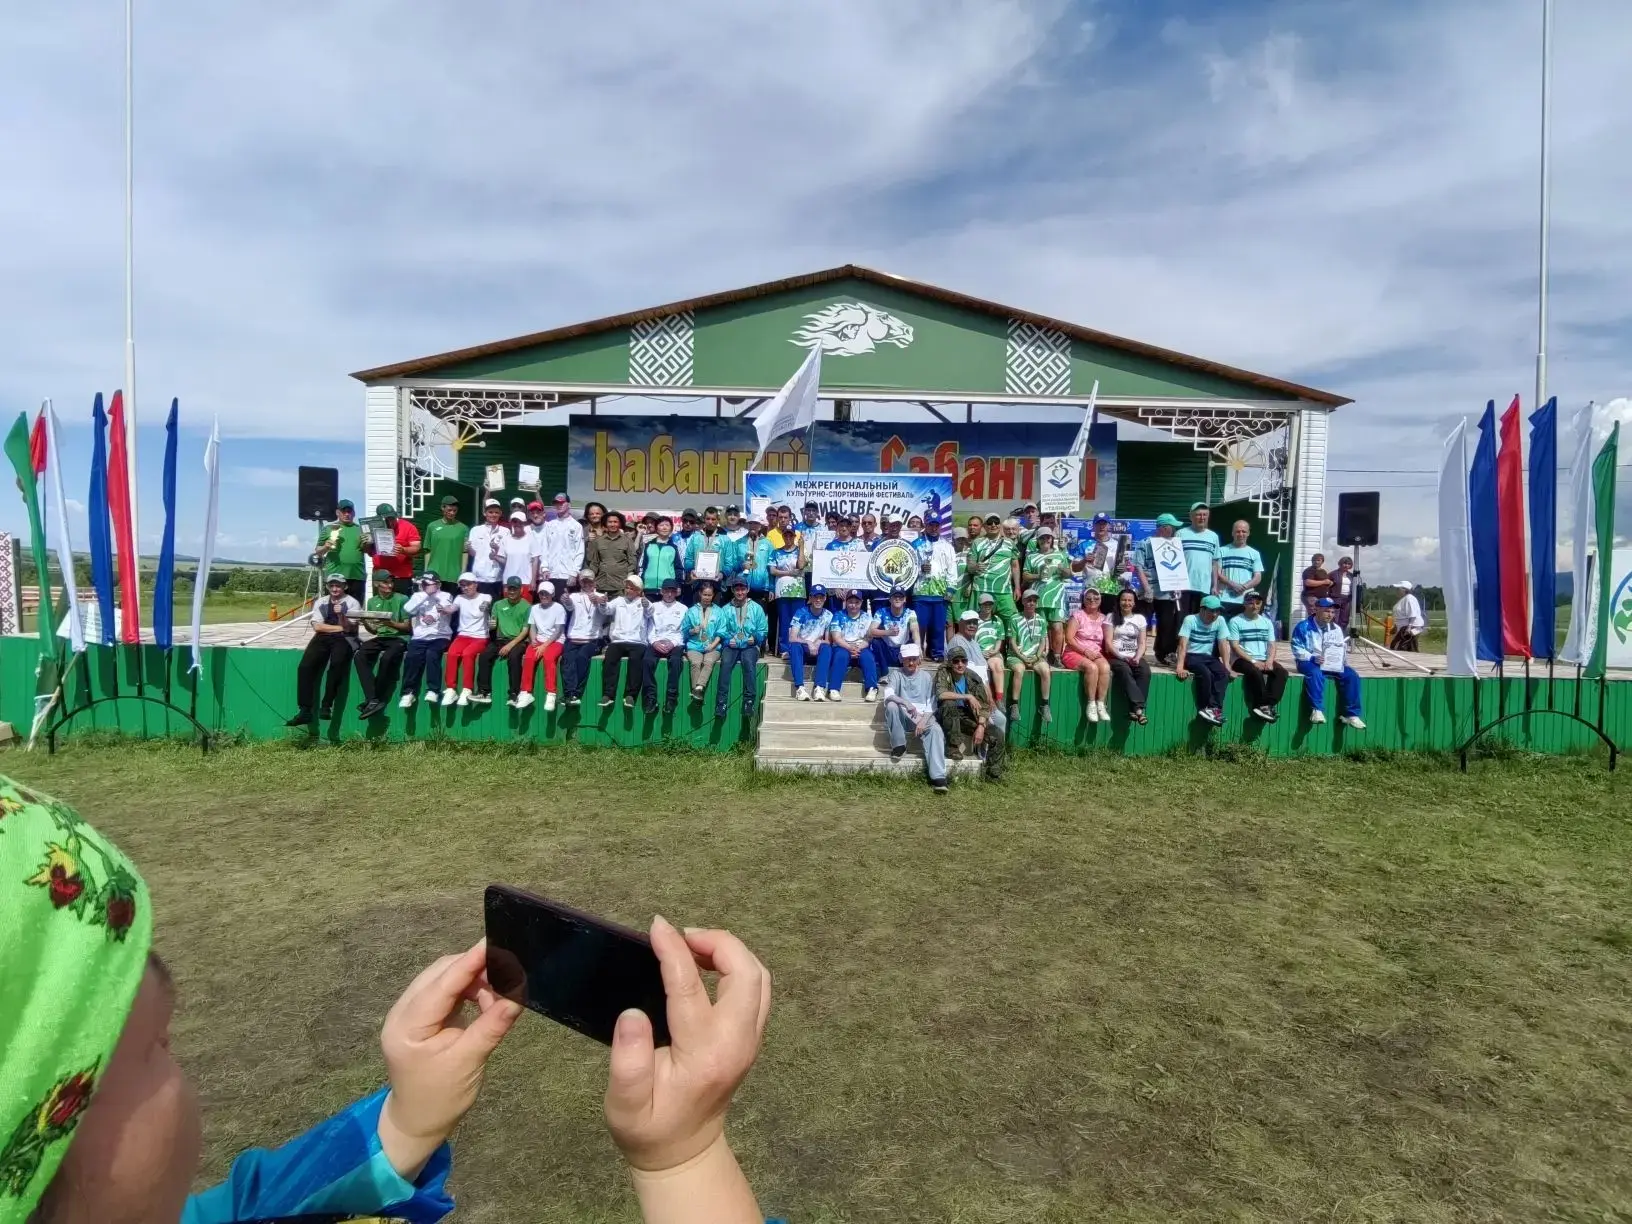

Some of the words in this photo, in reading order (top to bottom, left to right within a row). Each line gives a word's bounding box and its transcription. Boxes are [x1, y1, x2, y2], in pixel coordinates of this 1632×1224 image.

[794, 480, 898, 490] МЕЖРЕГИОНАЛЬНЫЙ
[786, 490, 874, 498] КУЛЬТУРНО-СПОРТИВНЫЙ
[875, 490, 914, 499] ФЕСТИВАЛЬ
